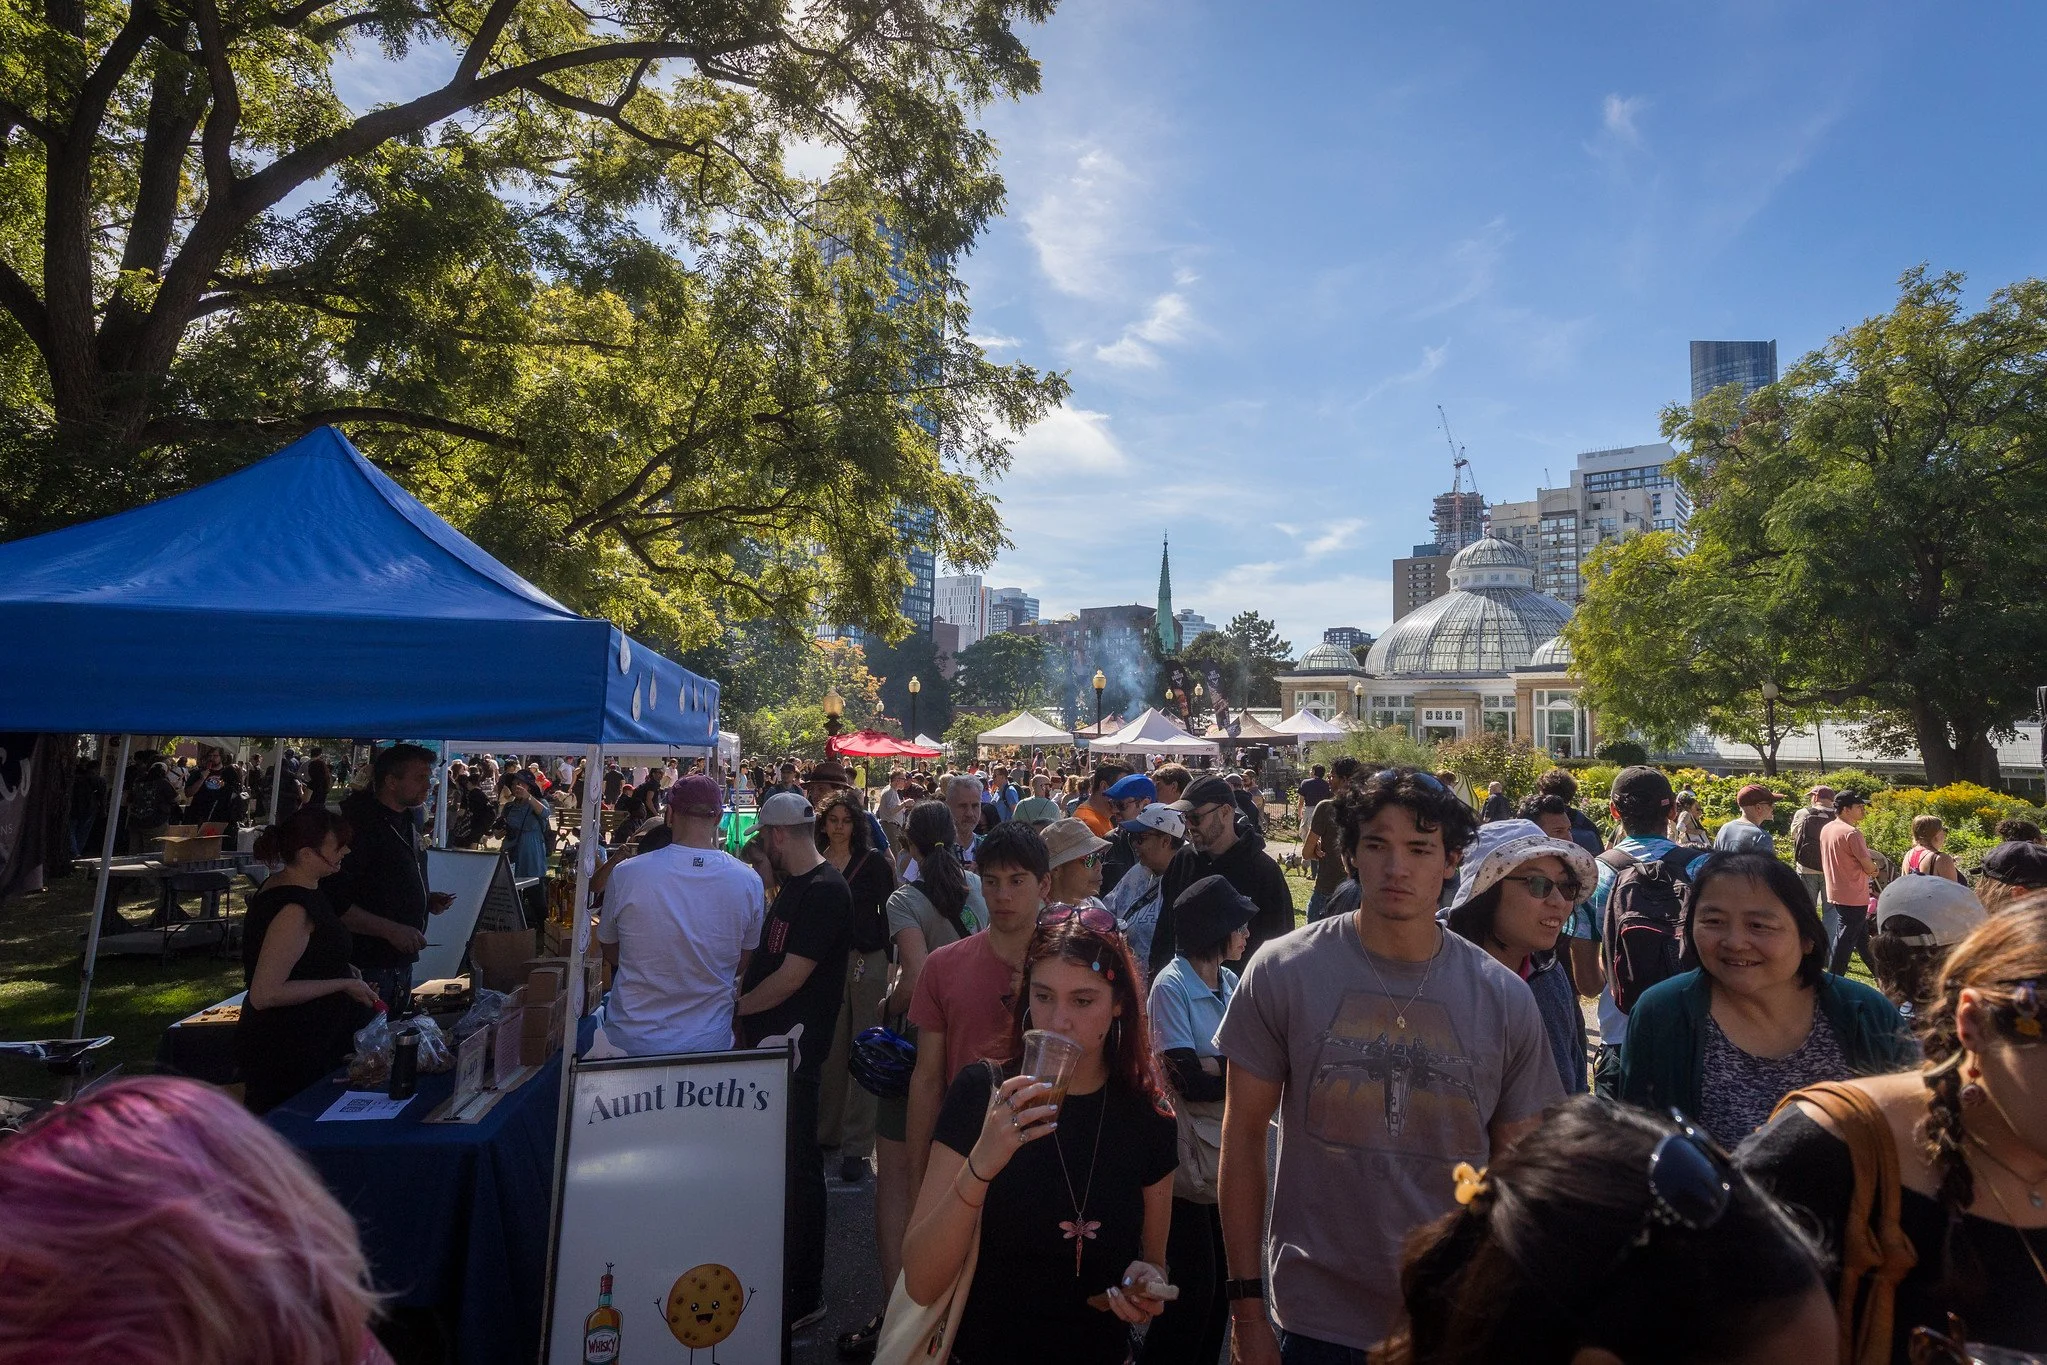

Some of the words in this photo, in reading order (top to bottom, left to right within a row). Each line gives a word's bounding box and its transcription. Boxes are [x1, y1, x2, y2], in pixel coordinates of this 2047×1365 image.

[587, 1084, 667, 1125] Aunt
[674, 1078, 770, 1111] Beth's
[588, 1337, 617, 1354] WHISKY
